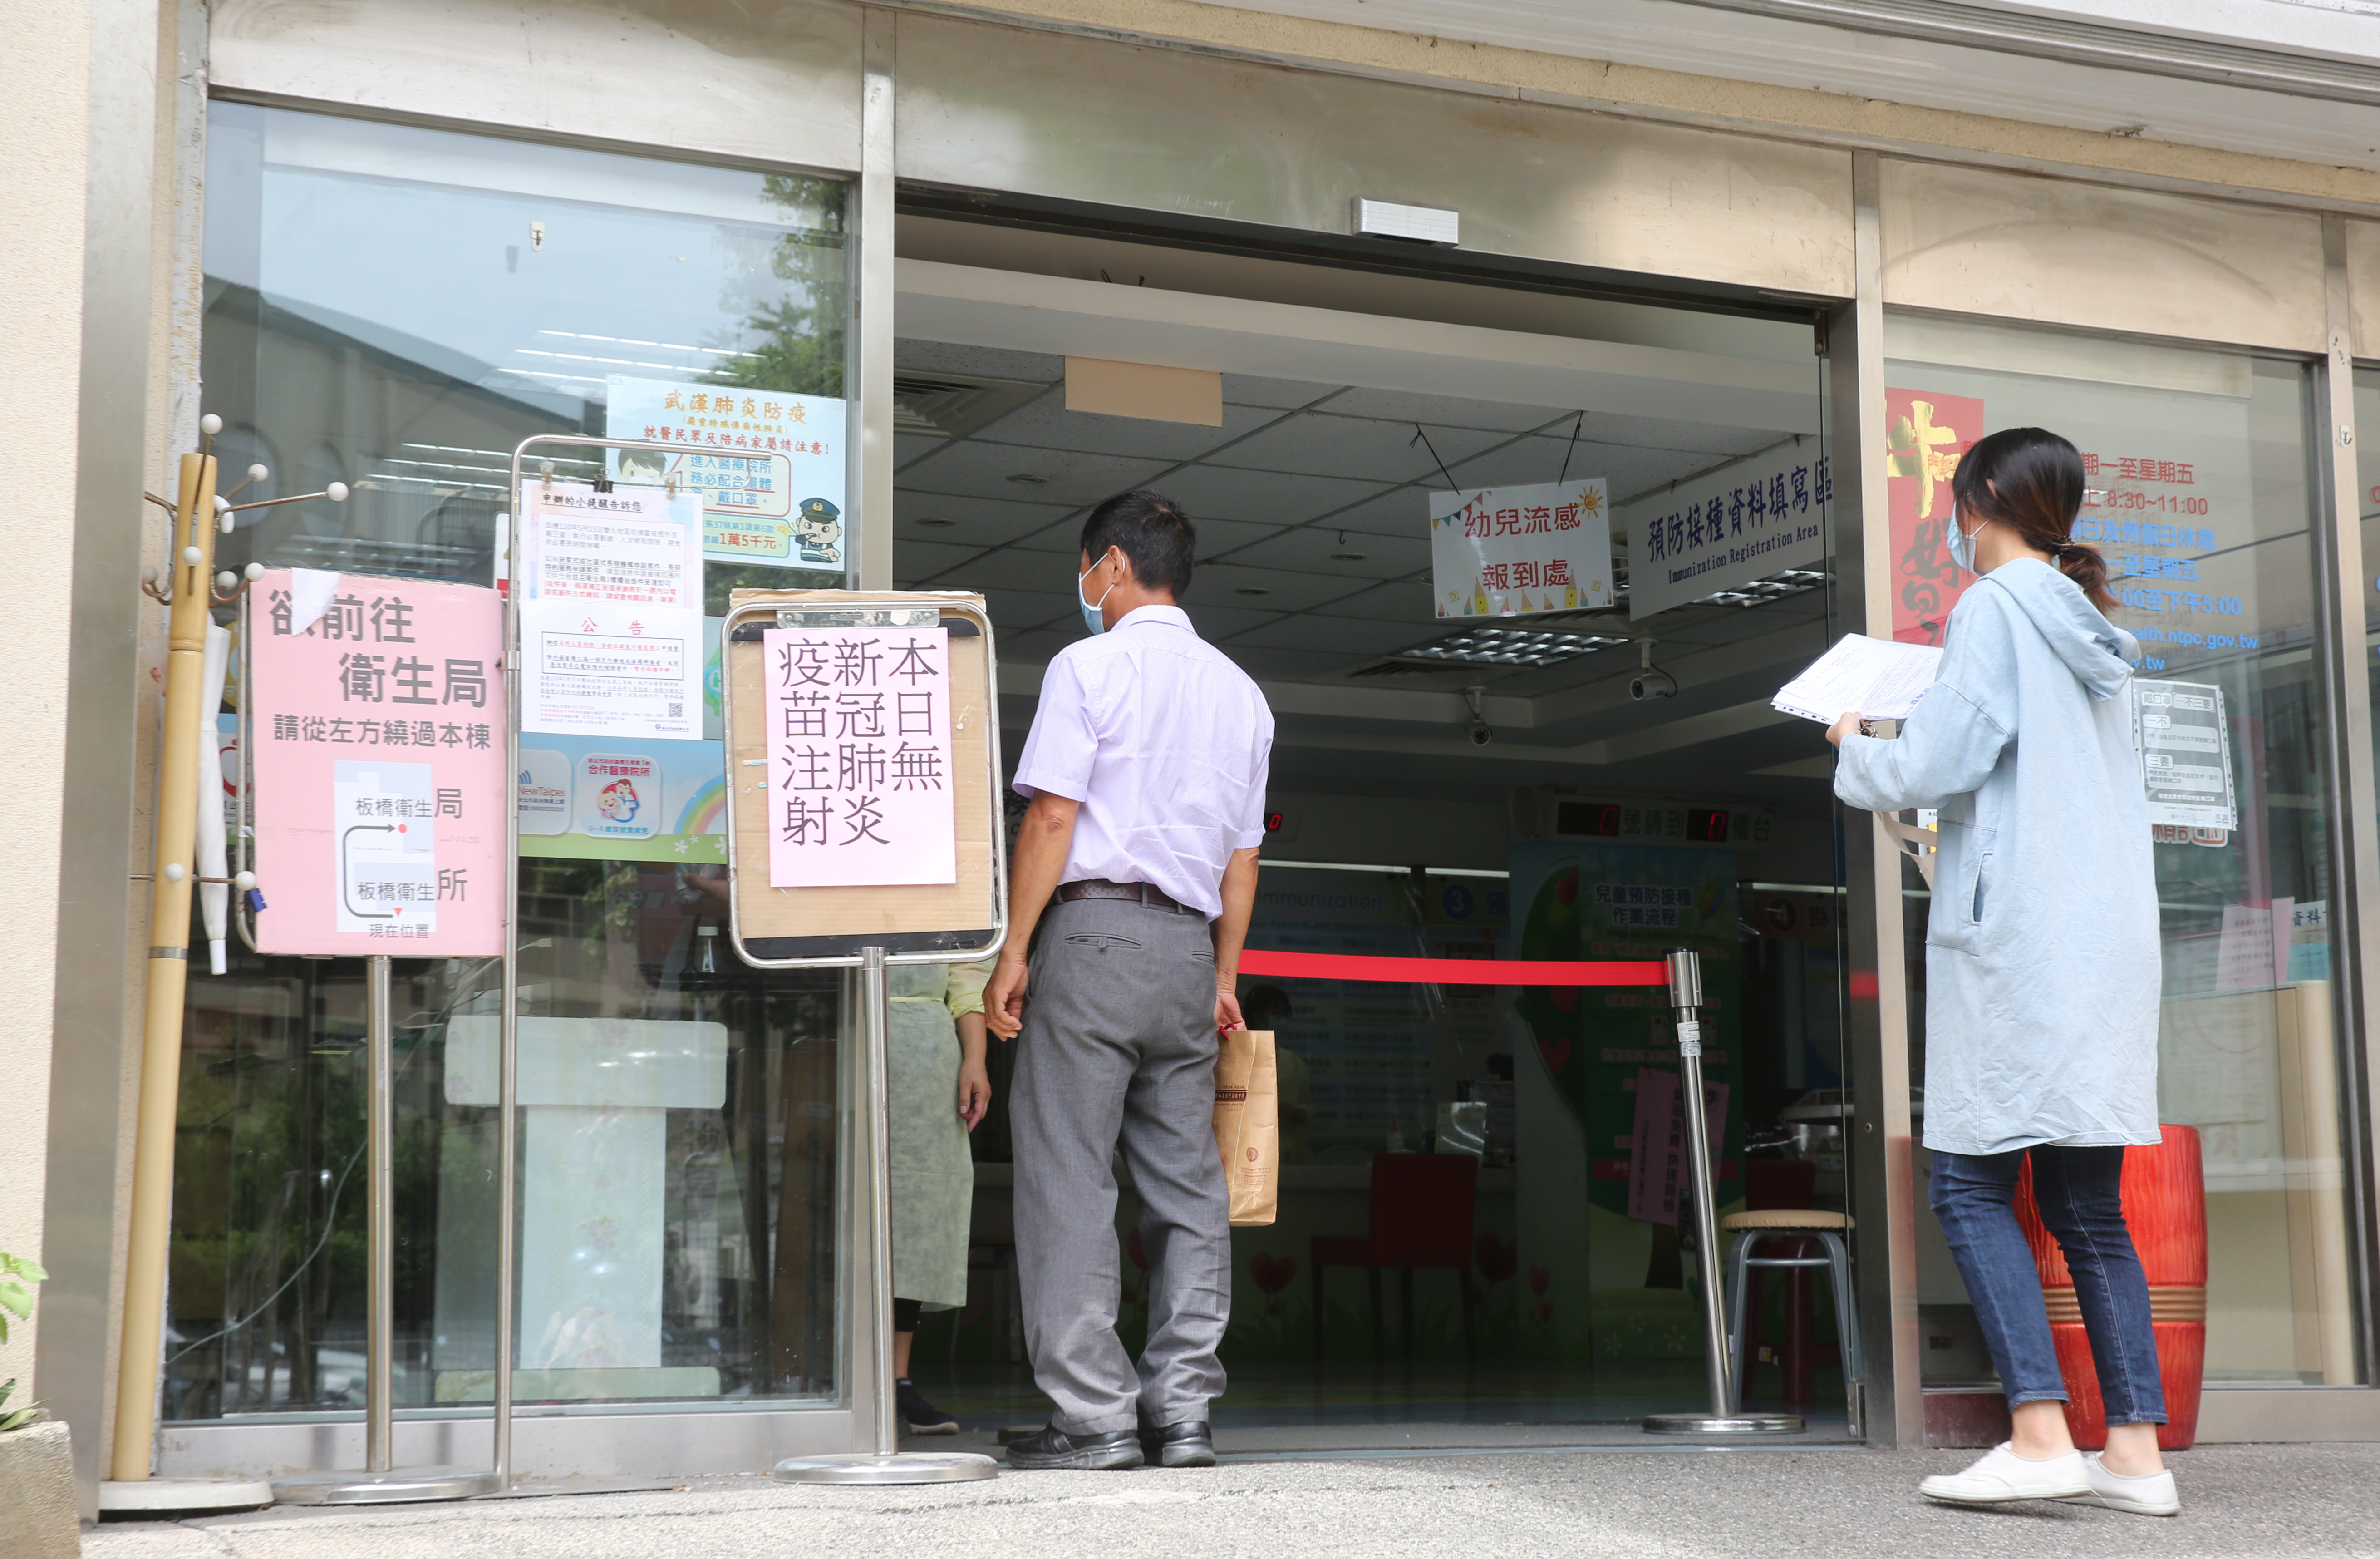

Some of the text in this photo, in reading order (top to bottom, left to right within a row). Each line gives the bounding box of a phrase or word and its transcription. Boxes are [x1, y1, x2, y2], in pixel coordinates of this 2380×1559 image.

[664, 389, 807, 424] 武漢肺炎防疫
[691, 455, 772, 474] 進入醫療院所
[690, 471, 772, 490] 務必配合量體
[1648, 456, 1833, 562] 預防接種資料填寫區
[2107, 489, 2208, 515] 8:30~11:00
[703, 520, 774, 533] 第37條第1項第6款
[1465, 503, 1580, 538] 幼兒流感
[1669, 524, 1818, 584] Immunization Registration Area
[1482, 559, 1569, 590] 報到處
[2105, 555, 2199, 581] 一至星期五
[581, 617, 644, 635] 公告
[2115, 623, 2258, 649] ealth.ntpc.gov.tw
[2129, 655, 2165, 670] v.tw
[339, 652, 487, 708] 衛生局
[888, 638, 942, 791] 本日無
[2147, 717, 2167, 727] 一不
[273, 714, 491, 750] 請從左方繞過本棟
[778, 638, 834, 846] 疫苗注射
[834, 638, 890, 846] 新冠肺炎
[589, 765, 650, 776] 合作醫療院所
[2150, 755, 2169, 767] 三要
[355, 788, 463, 819] 板橋衛生局
[518, 787, 565, 798] NewTaipei
[1269, 814, 1282, 829] 0
[1599, 807, 1618, 834] 0
[1623, 809, 1685, 836] 號請到
[1732, 813, 1770, 842] 櫃台
[357, 868, 468, 902] 板橋衛生所
[1595, 884, 1692, 907] 兒童預防接種
[1257, 889, 1382, 909] Immunization
[1451, 890, 1465, 913] 3
[1613, 908, 1677, 927] 作業流程
[2294, 908, 2326, 926] 資料
[369, 923, 430, 939] 現在位置
[1607, 929, 1628, 939] Steps
[1630, 930, 1641, 938] for
